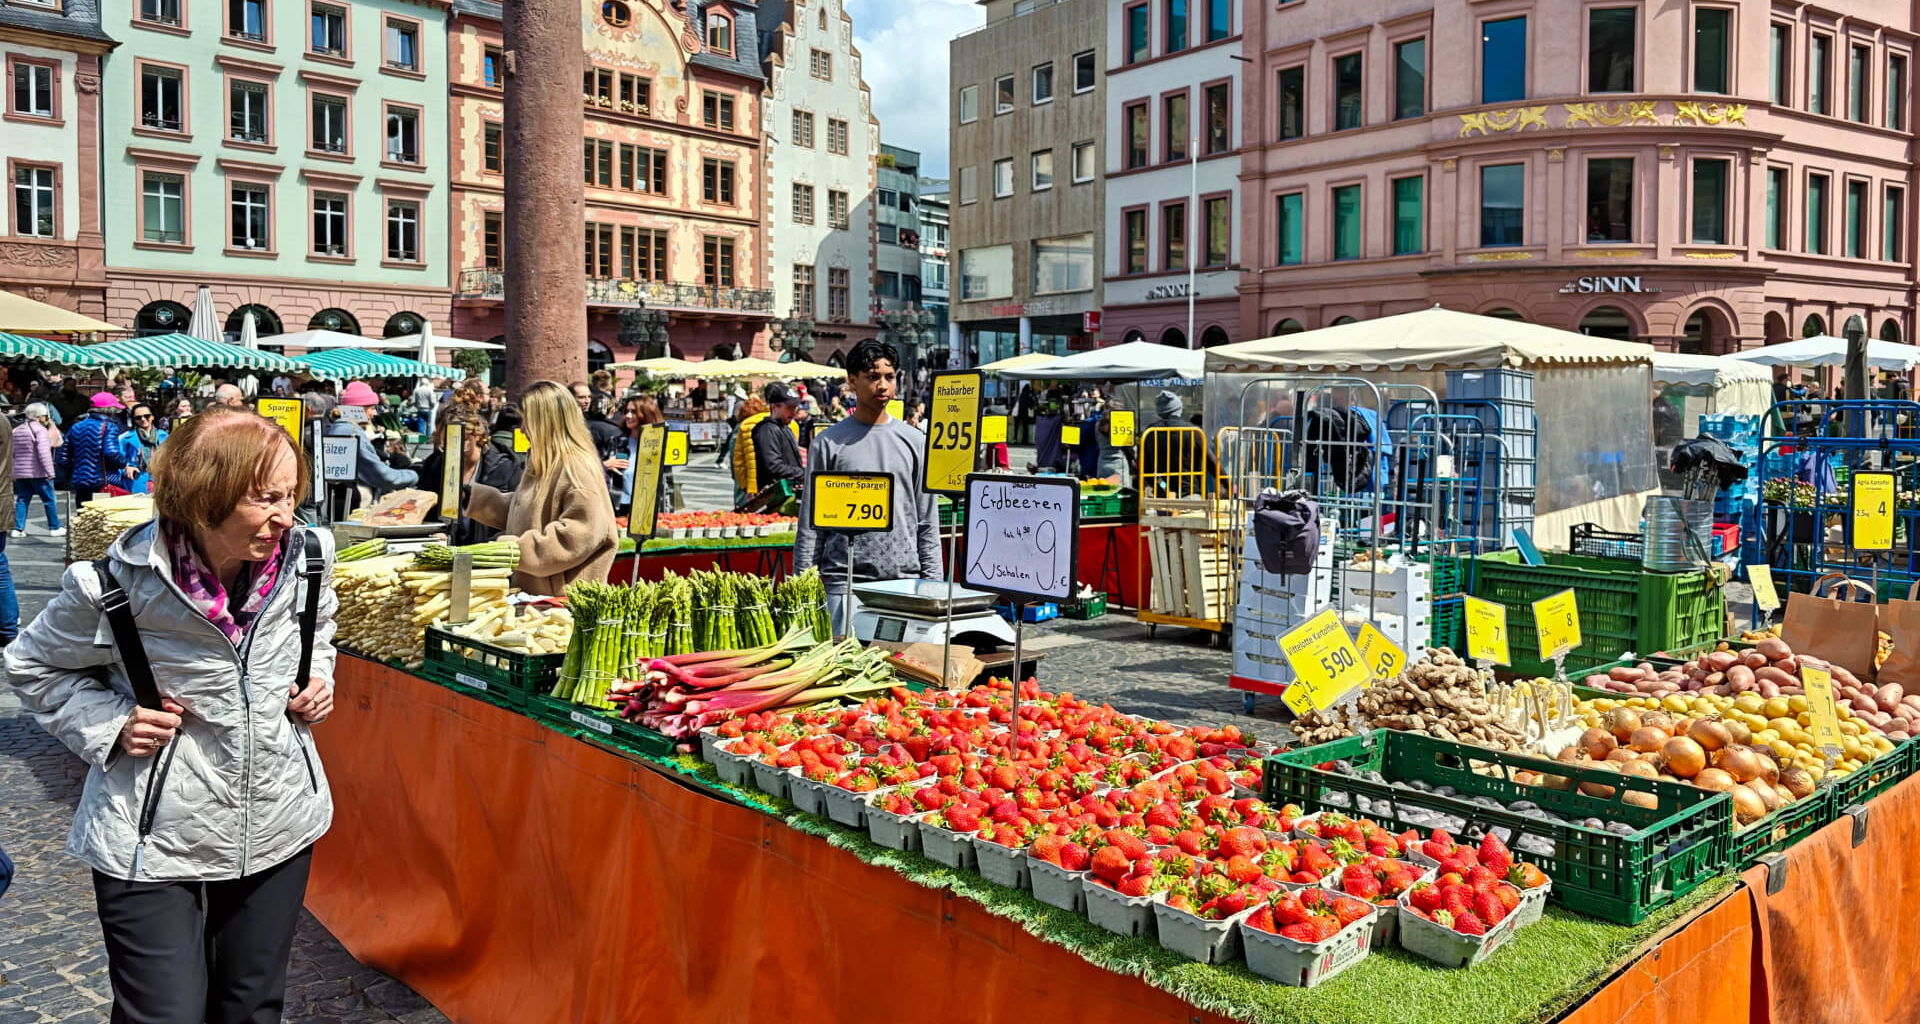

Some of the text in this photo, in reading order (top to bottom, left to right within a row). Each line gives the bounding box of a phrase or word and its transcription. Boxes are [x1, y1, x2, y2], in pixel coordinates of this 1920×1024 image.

[937, 386, 975, 396] Rhabarber
[267, 404, 297, 413] Spargel
[672, 448, 680, 461] 9
[825, 480, 887, 491] Grüner Spargel
[980, 485, 1062, 512] Erdbeeren
[1877, 500, 1887, 517] 4
[996, 564, 1031, 580] Schalen
[1566, 612, 1573, 627] 8
[1494, 625, 1500, 641] 7
